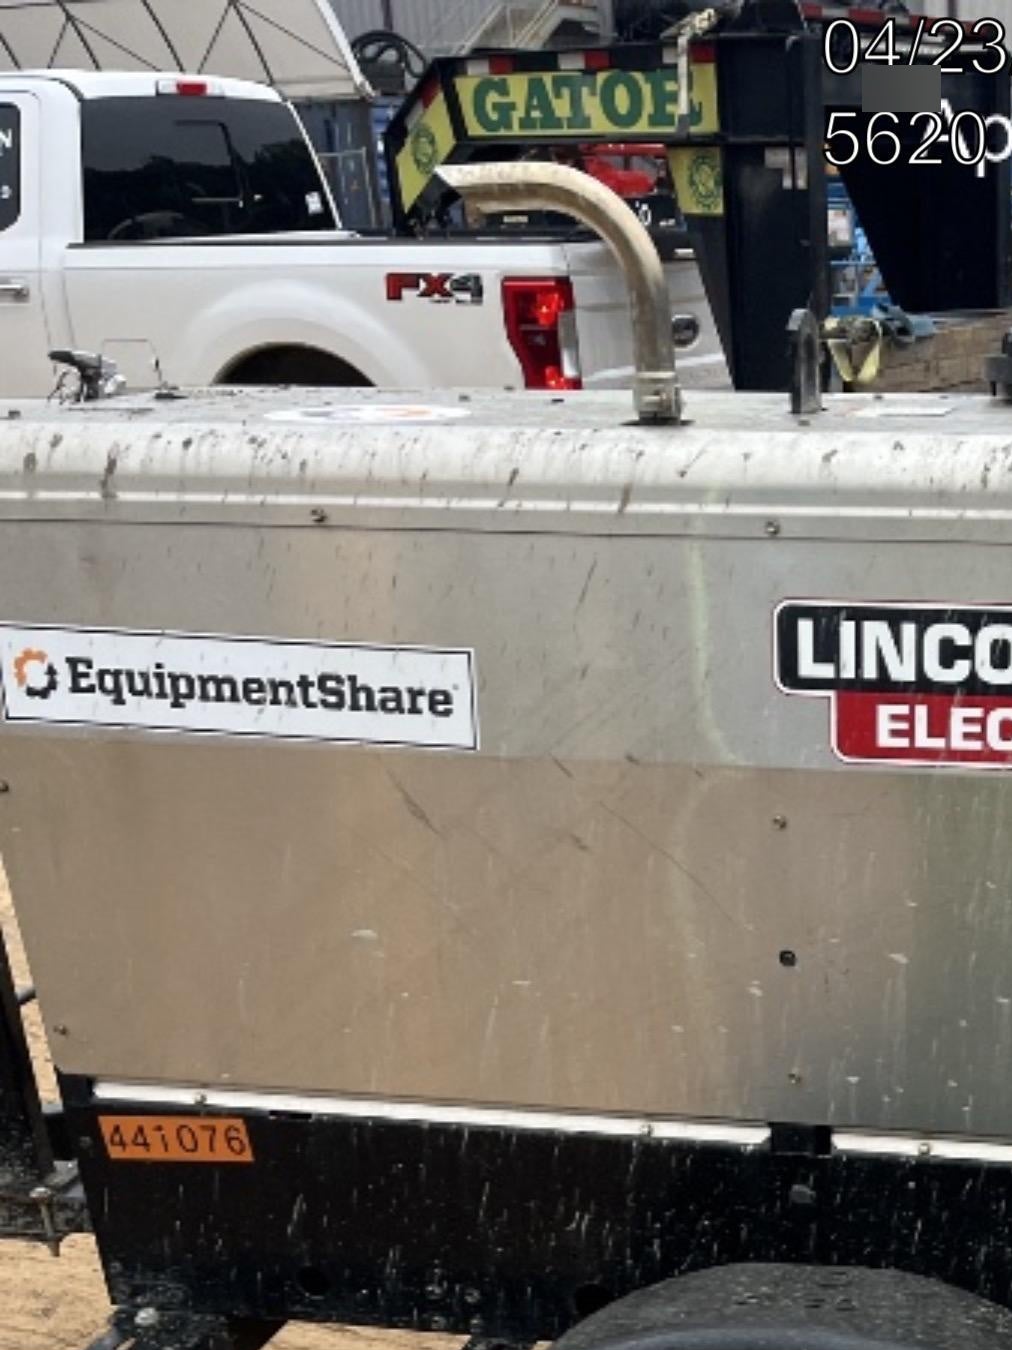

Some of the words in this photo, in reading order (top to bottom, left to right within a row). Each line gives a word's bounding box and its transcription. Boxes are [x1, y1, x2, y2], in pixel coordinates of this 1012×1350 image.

[386, 273, 483, 305] FX4
[65, 656, 454, 717] EquipmentShare
[109, 1124, 246, 1155] 441076
